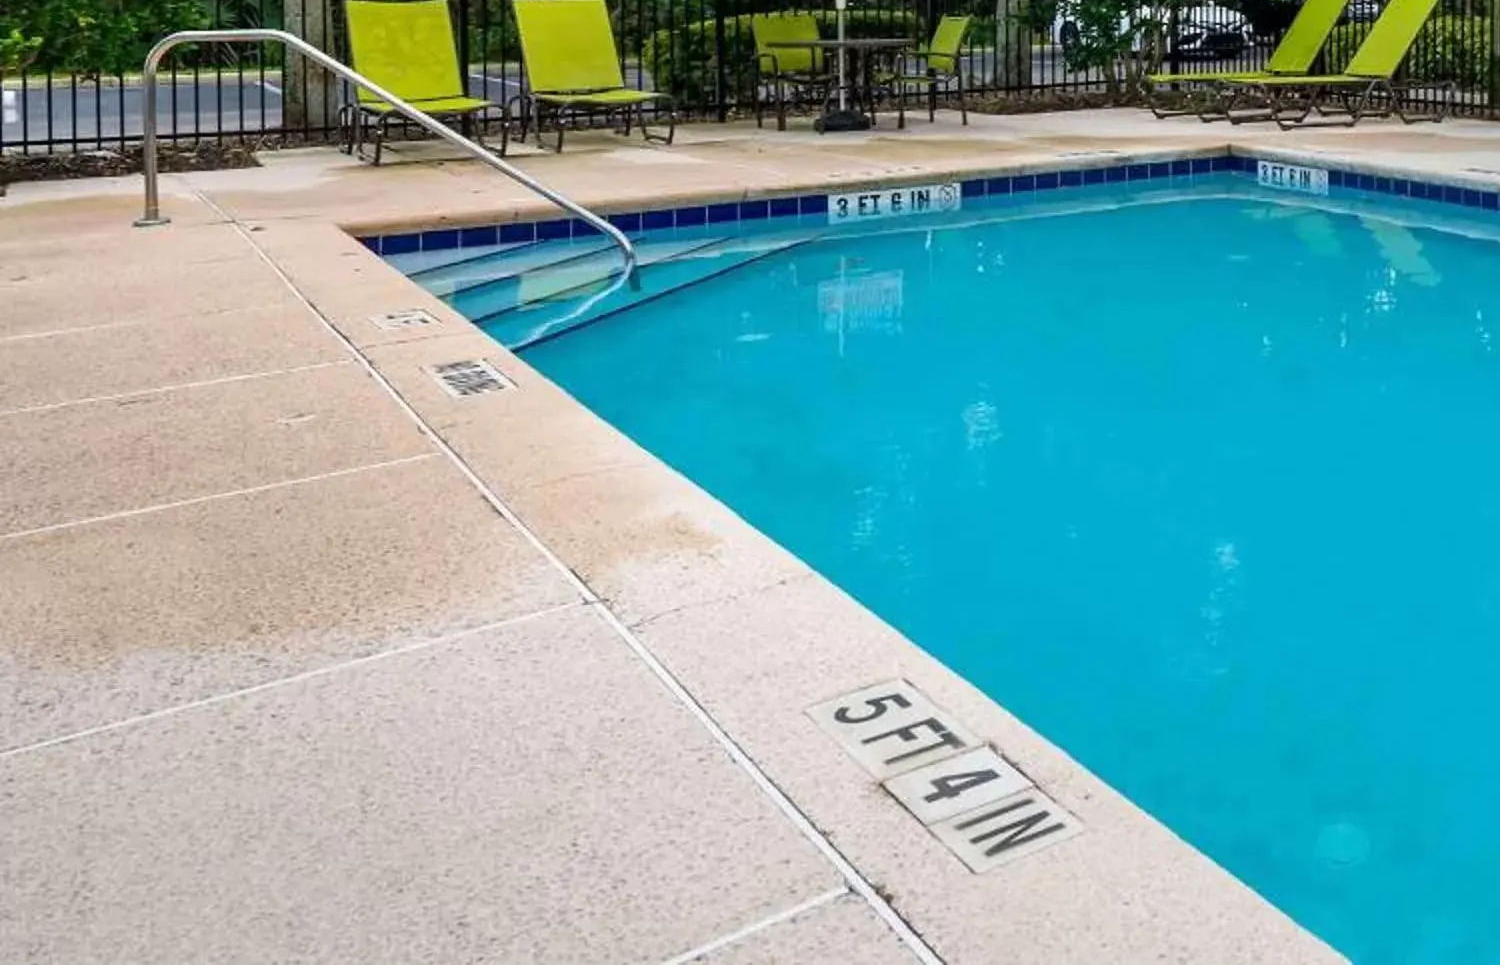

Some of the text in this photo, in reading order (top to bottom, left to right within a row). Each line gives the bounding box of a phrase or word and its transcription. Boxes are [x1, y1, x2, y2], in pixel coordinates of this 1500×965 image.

[911, 189, 929, 205] IN
[834, 693, 1066, 857] 5 FT 4 IN
